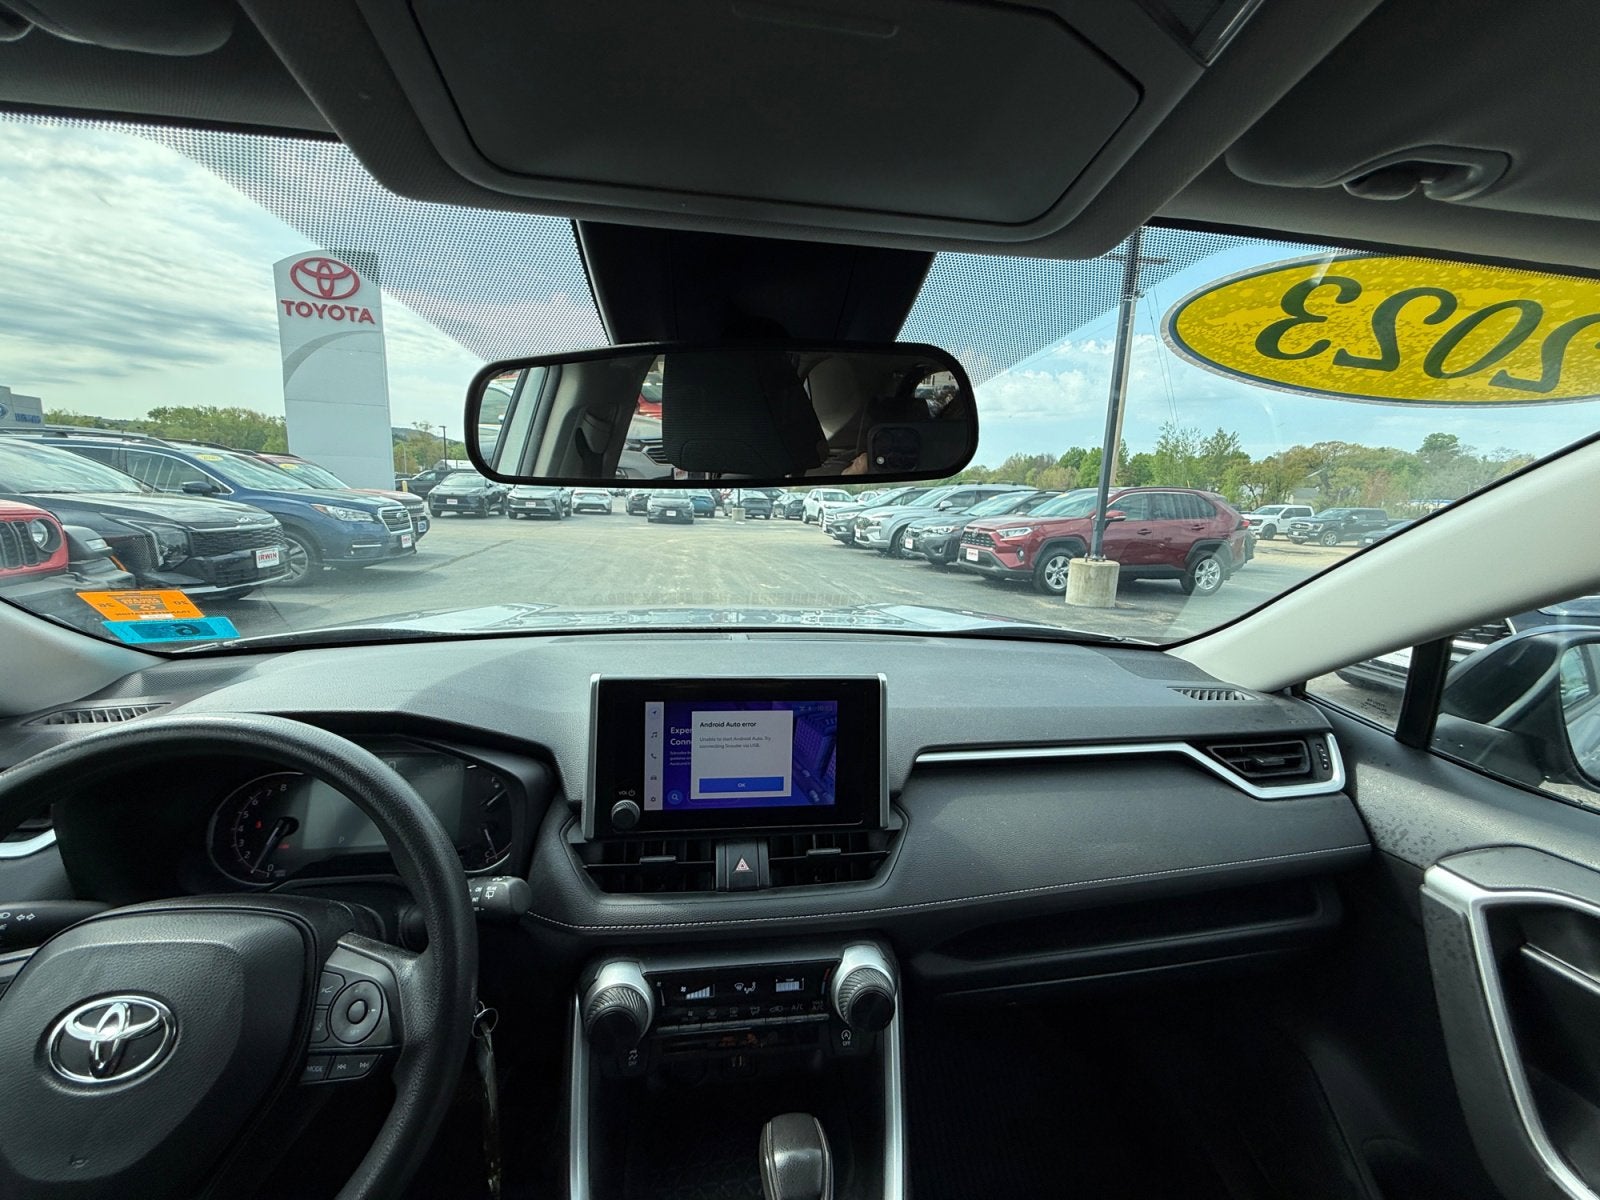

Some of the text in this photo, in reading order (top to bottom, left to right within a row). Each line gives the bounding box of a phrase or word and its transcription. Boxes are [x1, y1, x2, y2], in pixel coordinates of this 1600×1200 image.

[281, 299, 376, 325] TOYOTA
[258, 552, 278, 562] IRWIN
[670, 738, 692, 746] Conn
[306, 1065, 324, 1073] MODE
